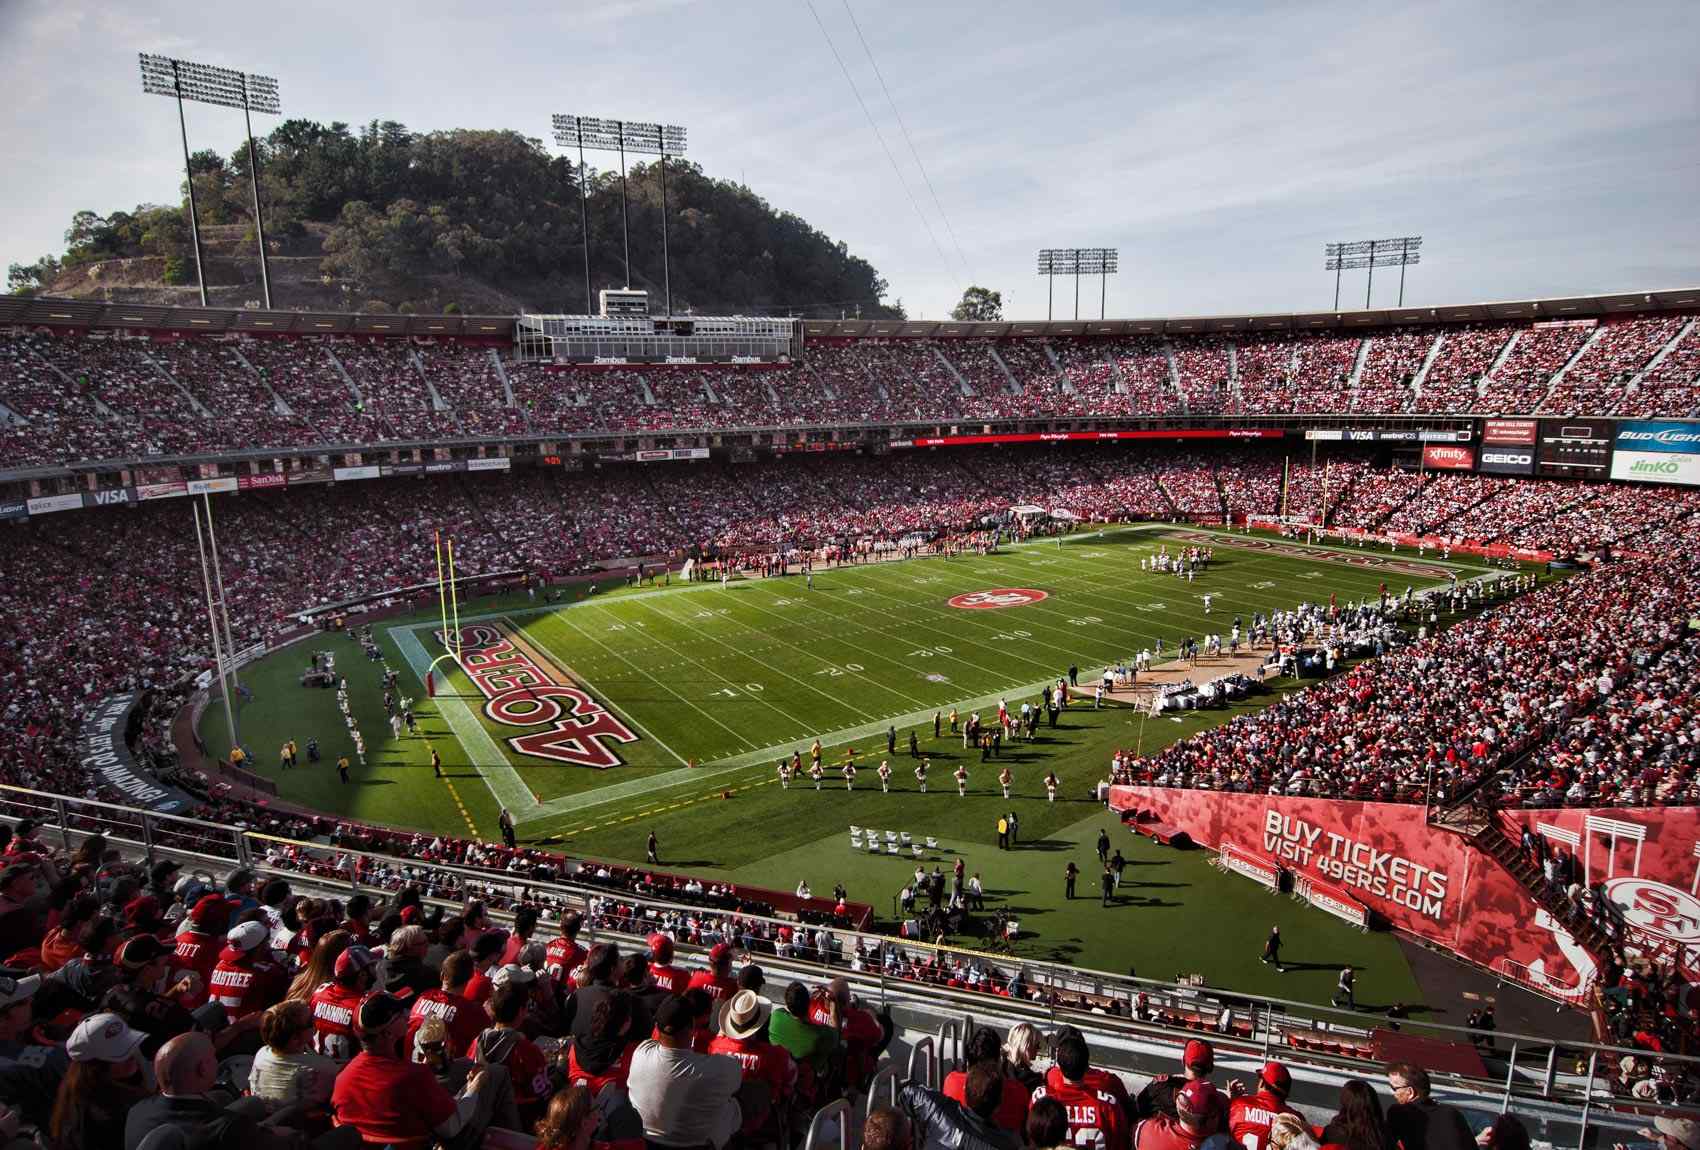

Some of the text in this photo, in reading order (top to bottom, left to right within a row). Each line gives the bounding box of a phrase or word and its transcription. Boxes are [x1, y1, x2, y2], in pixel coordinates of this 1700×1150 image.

[665, 355, 696, 364] Rambus
[1350, 431, 1374, 440] VISA
[1618, 431, 1654, 440] BUD
[1430, 447, 1466, 460] xfinity
[1482, 454, 1531, 464] GEICO
[95, 489, 129, 505] VISA
[824, 662, 865, 678] 20
[434, 625, 641, 769] 49ERS
[721, 682, 764, 698] 10
[100, 764, 168, 802] AMAZING!
[1266, 809, 1448, 898] BUY TICKETS
[1263, 832, 1313, 866] VISIT
[1317, 854, 1442, 920] 49ERS.COM
